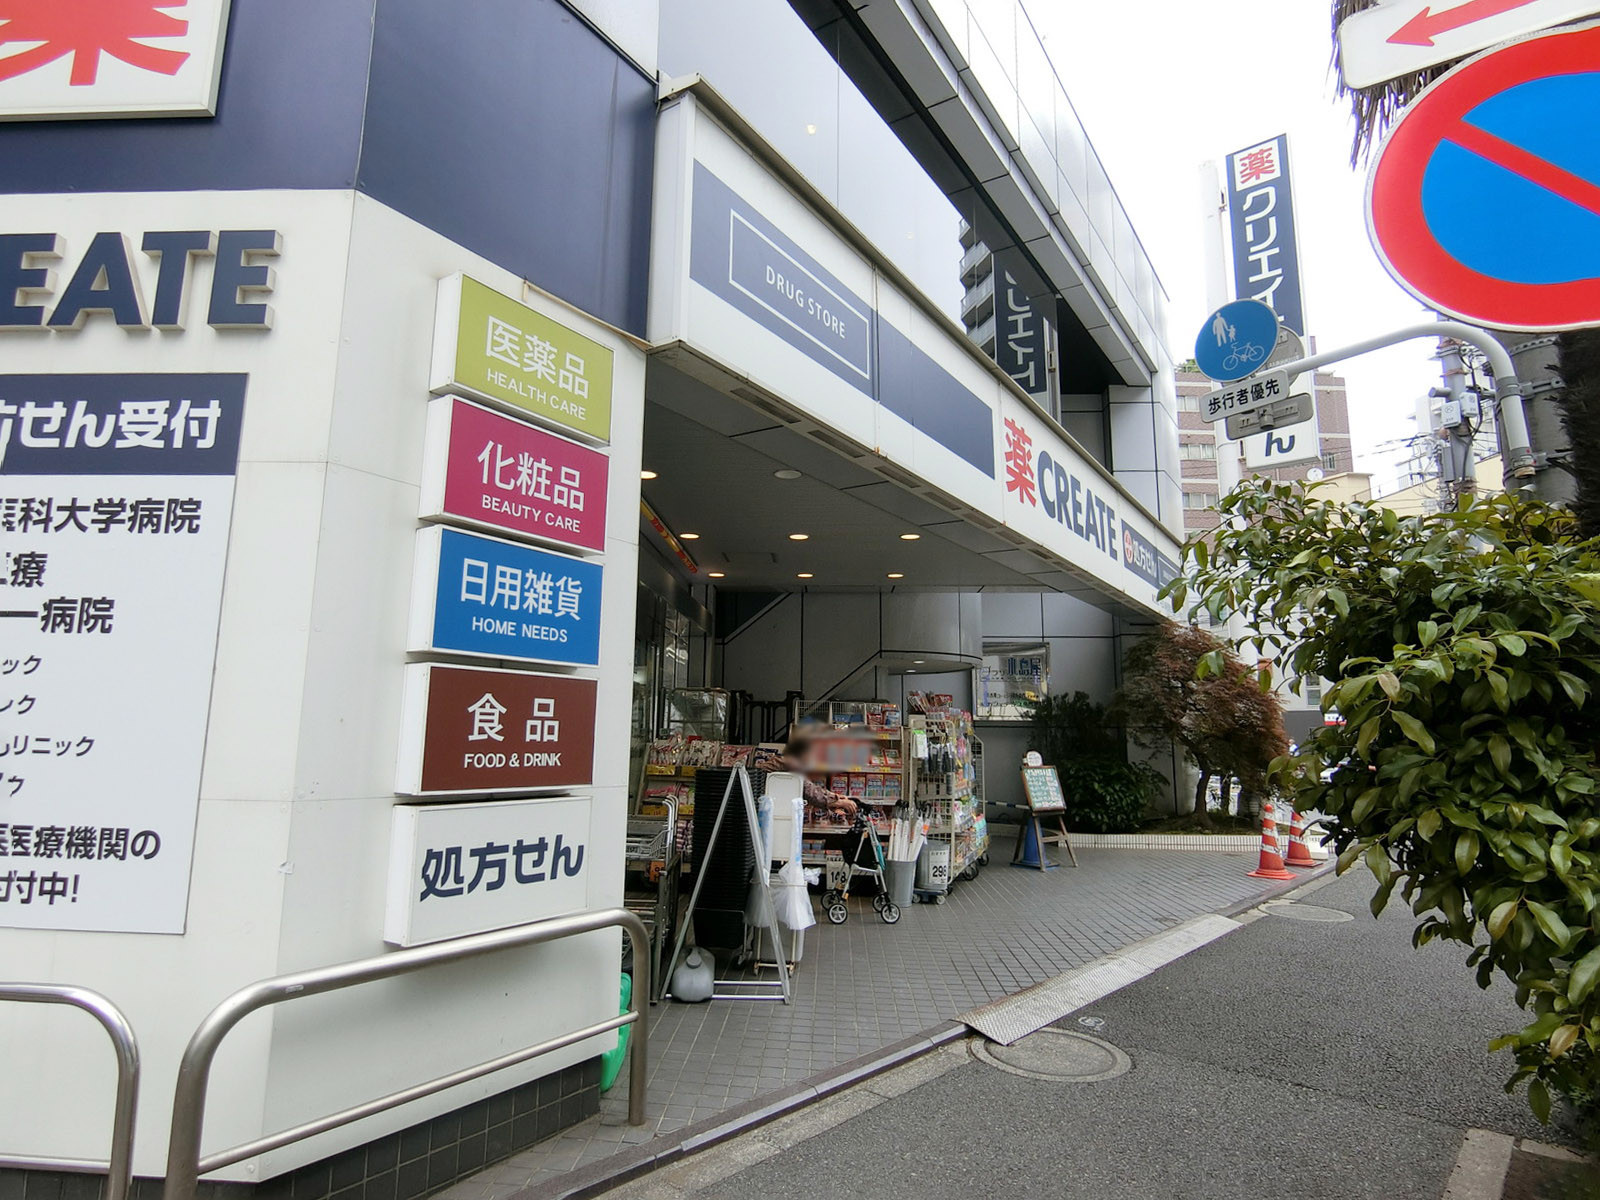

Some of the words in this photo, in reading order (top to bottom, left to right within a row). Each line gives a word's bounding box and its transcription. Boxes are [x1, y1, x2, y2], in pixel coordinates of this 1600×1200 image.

[1240, 147, 1275, 184] 薬
[1243, 186, 1285, 322] クリエイ
[766, 265, 804, 308] DRUG
[808, 298, 846, 339] STORE
[486, 315, 589, 399] 医薬品
[487, 367, 547, 405] HEALTH
[549, 395, 587, 421] CARE
[1208, 378, 1280, 416] 歩行者優先
[478, 440, 585, 512] 化粧品
[1004, 417, 1037, 507] 薬
[1037, 450, 1118, 561] CREATE
[482, 495, 542, 522] BEAUTY
[545, 512, 581, 533] CARE
[0, 551, 48, 588] 療
[460, 557, 583, 621] 日用雑貨
[472, 616, 517, 637] HOME
[522, 623, 568, 643] NEEDS
[467, 692, 560, 743] 食品
[464, 753, 506, 768] FOOD
[509, 753, 520, 768] &
[523, 752, 561, 768] DRINK
[419, 833, 584, 903] 処方せん
